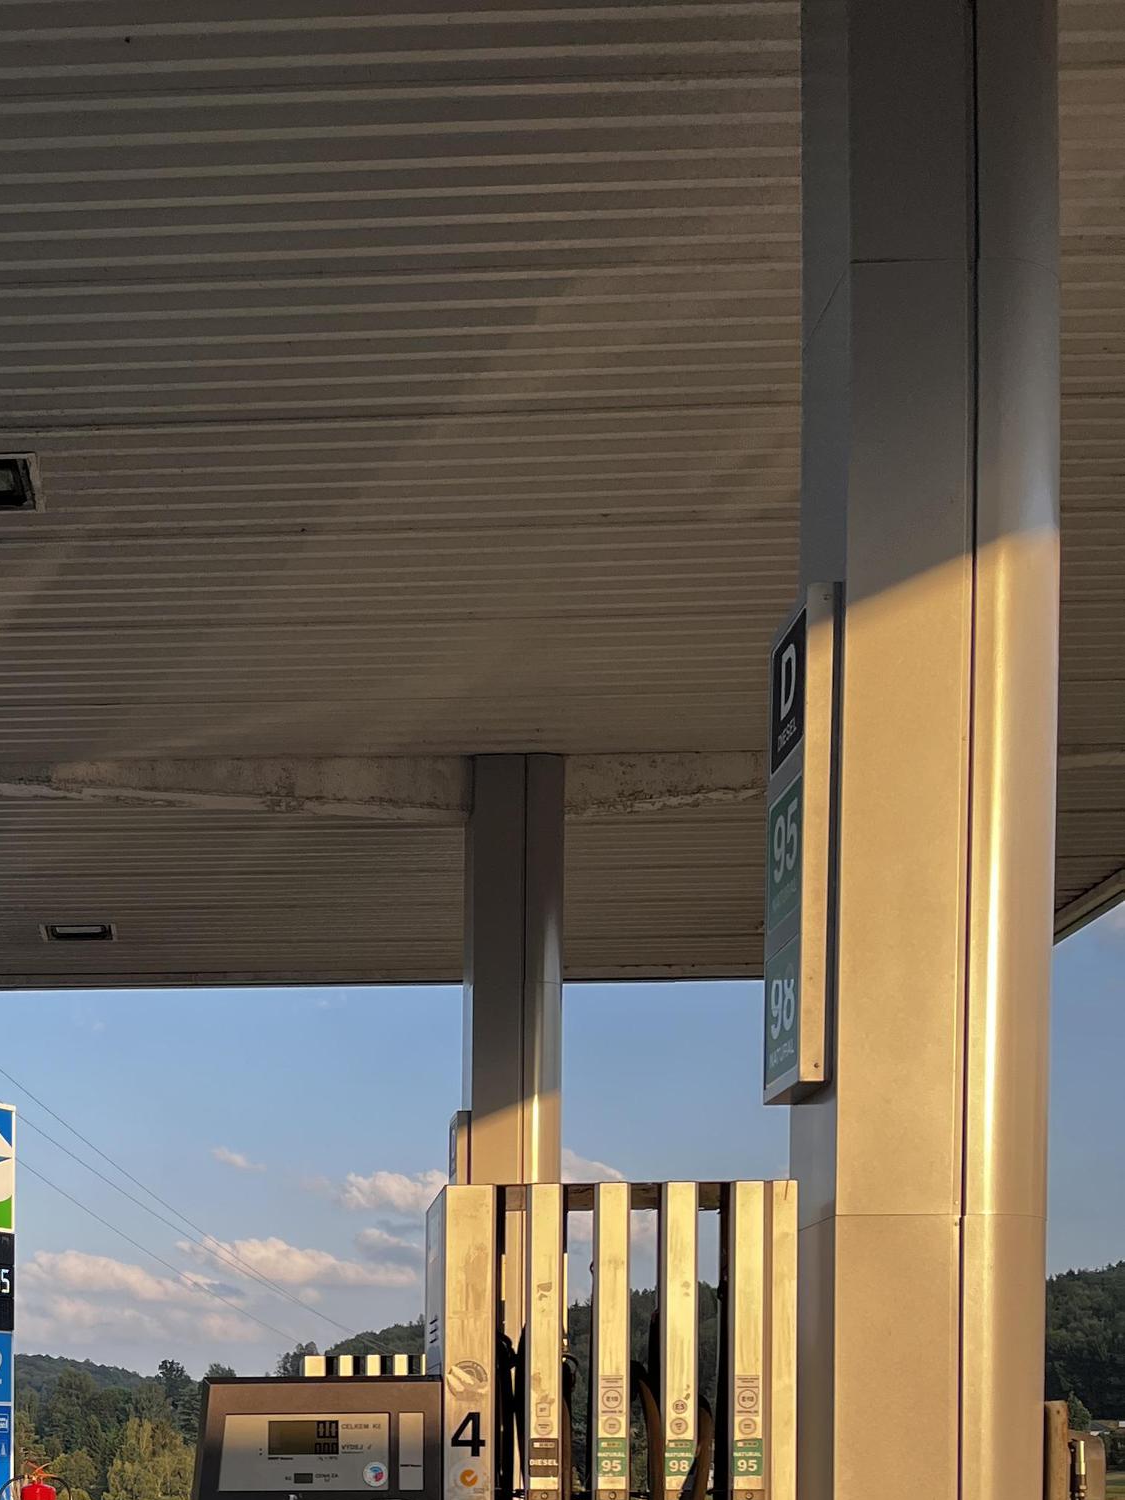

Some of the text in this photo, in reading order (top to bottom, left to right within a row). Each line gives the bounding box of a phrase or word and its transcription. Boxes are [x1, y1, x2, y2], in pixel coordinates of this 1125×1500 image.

[780, 642, 796, 721] D
[777, 716, 797, 752] DIESEL
[774, 798, 798, 883] 95
[771, 962, 795, 1040] 98
[451, 1412, 485, 1457] 4
[601, 1460, 621, 1472] 95
[668, 1460, 689, 1472] 98
[737, 1460, 757, 1472] 95
